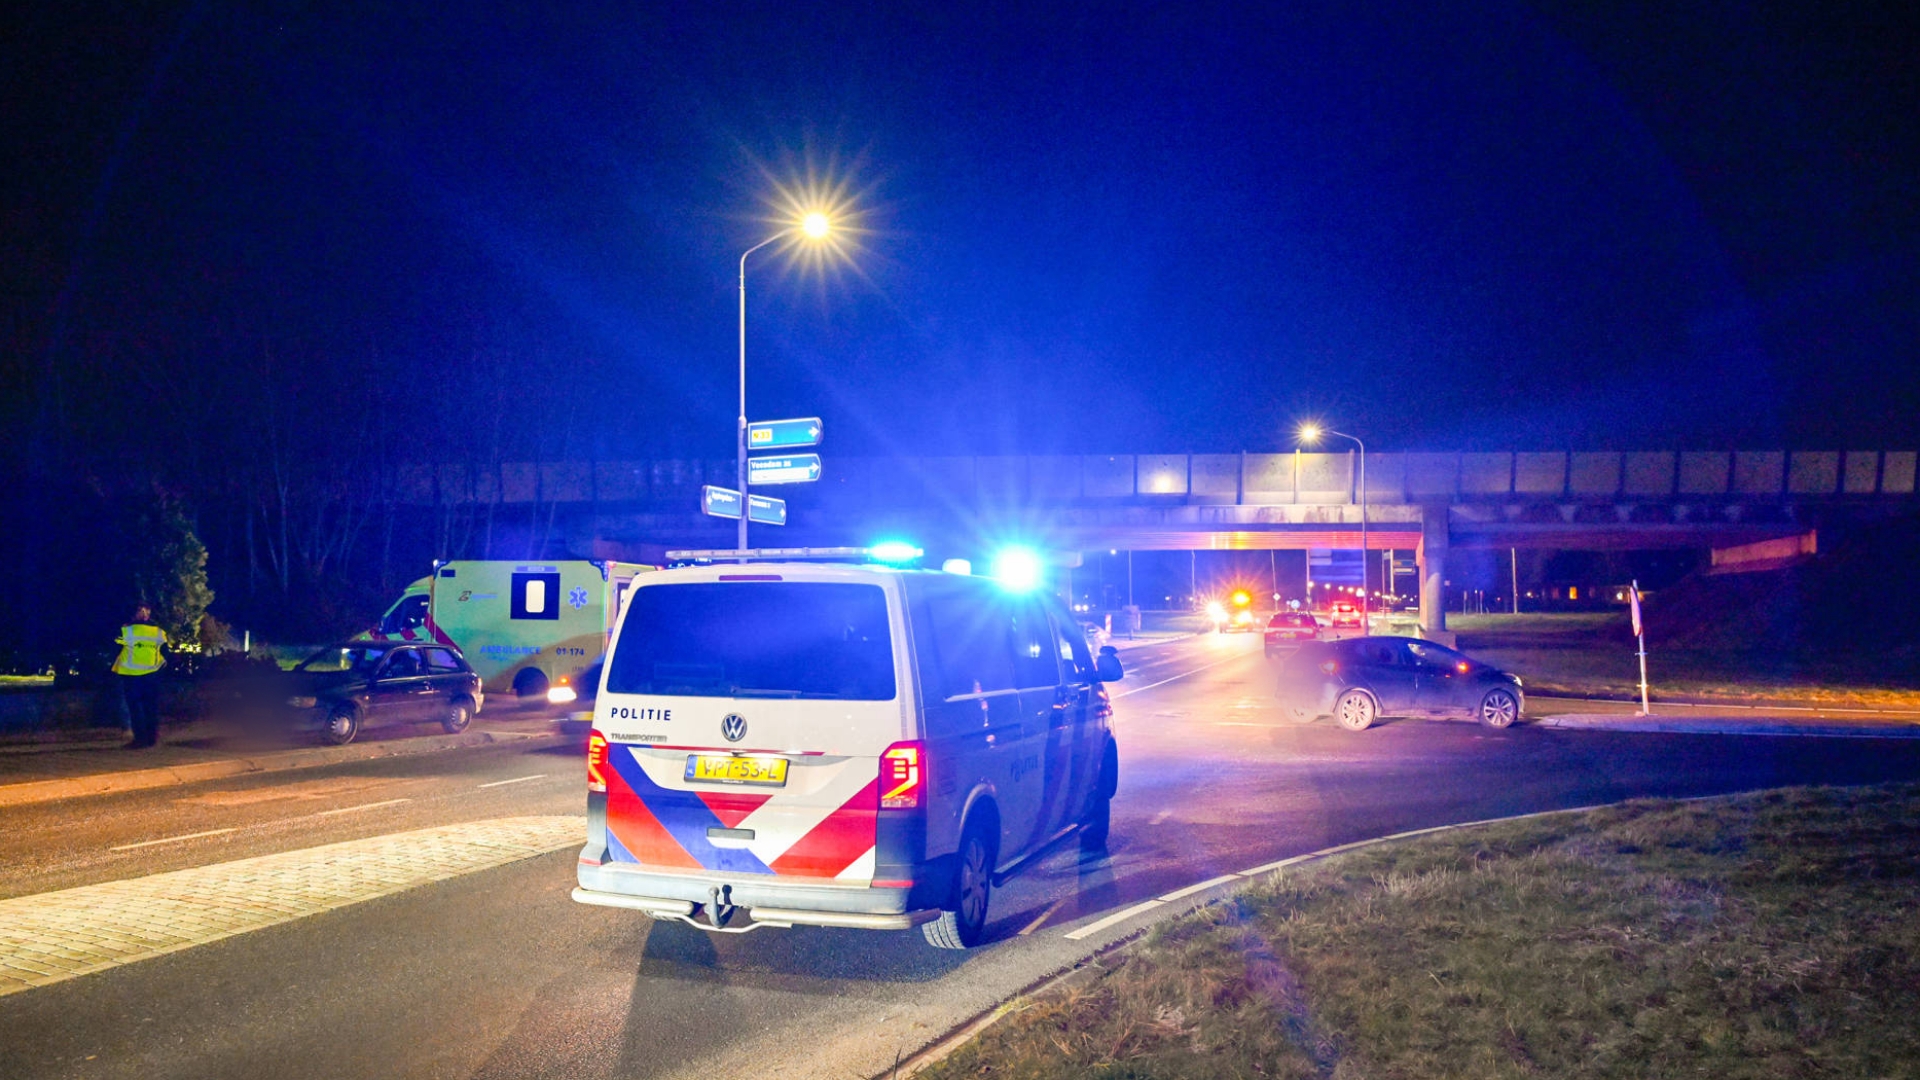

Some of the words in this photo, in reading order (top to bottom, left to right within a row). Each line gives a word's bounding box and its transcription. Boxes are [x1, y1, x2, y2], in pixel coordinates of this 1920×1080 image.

[753, 431, 770, 440] N33
[480, 645, 541, 655] AMBULANCE
[611, 707, 672, 721] POLITIE
